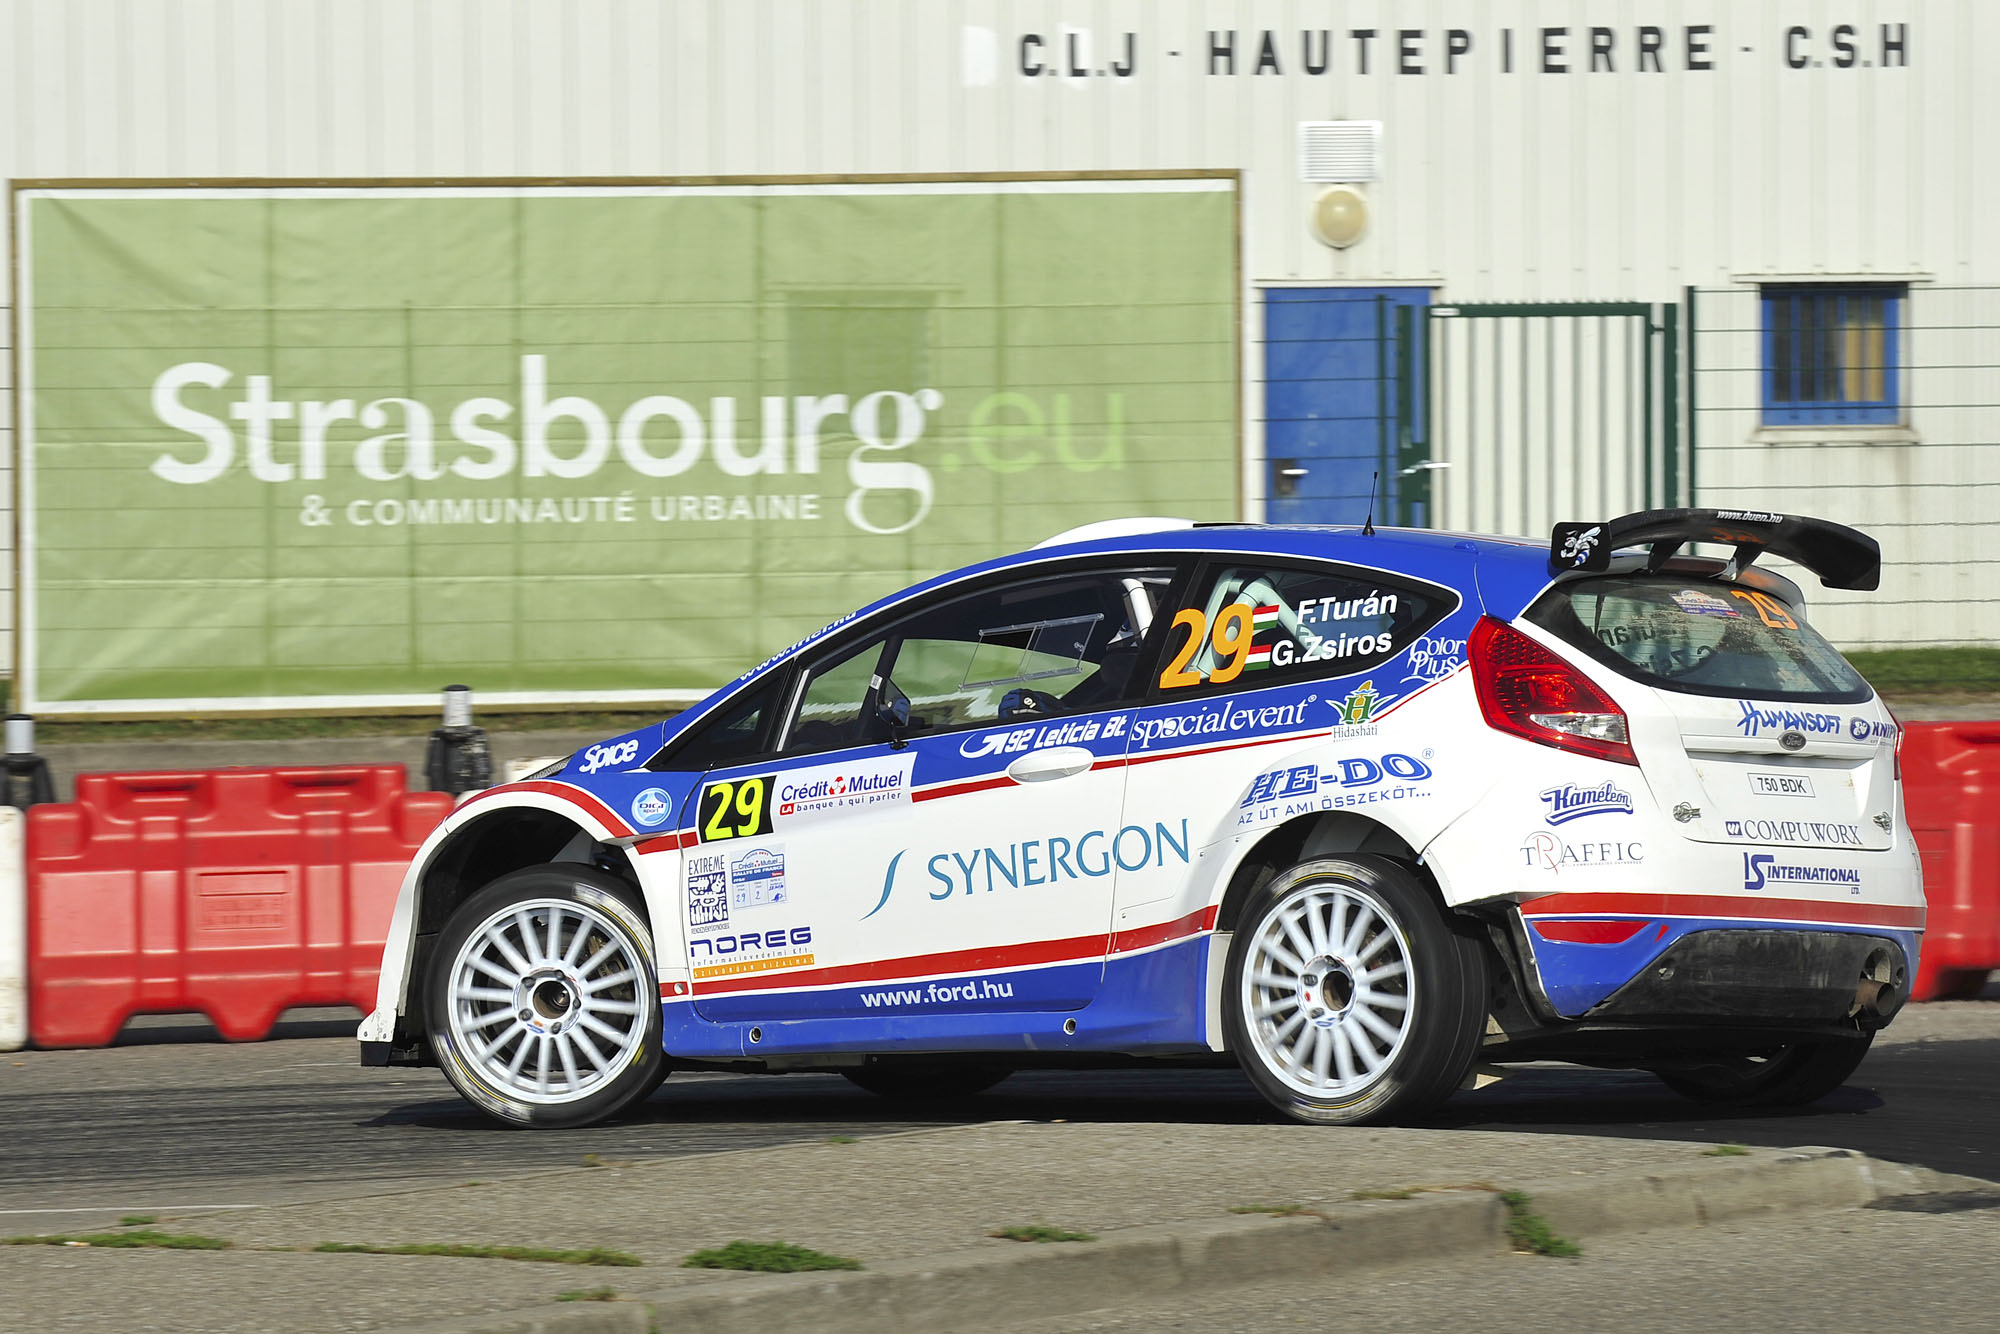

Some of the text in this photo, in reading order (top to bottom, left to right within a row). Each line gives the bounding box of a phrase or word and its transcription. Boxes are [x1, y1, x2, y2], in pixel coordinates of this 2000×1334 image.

[1018, 31, 1138, 78] C.L.J
[1205, 24, 1717, 76] HAUTEPIERRE
[1785, 22, 1910, 70] C.S.H
[346, 490, 637, 526] COMMUNAUTÉ
[650, 494, 820, 522] URBAINE
[1297, 590, 1398, 624] F.Turán
[1730, 589, 1798, 630] 29
[1159, 602, 1255, 689] 29
[1271, 632, 1393, 667] G.Zsiros
[578, 739, 639, 774] Spice
[781, 770, 903, 802] Crédit Mutuel
[1240, 753, 1432, 809] HE-DO
[1757, 777, 1807, 793] 750 BDK
[704, 778, 764, 841] 29
[781, 804, 794, 815] LA
[796, 801, 834, 812] banque
[848, 796, 865, 807] qui
[869, 792, 901, 804] parler
[1285, 802, 1314, 816] AMI
[1744, 819, 1863, 845] COMPUWORX
[688, 855, 725, 876] EXTREME
[927, 818, 1190, 901] SYNERGON
[1519, 834, 1645, 876] TRAFFIC
[1767, 865, 1860, 882] INTERNATIONAL
[860, 980, 1014, 1008] www.ford.hu
